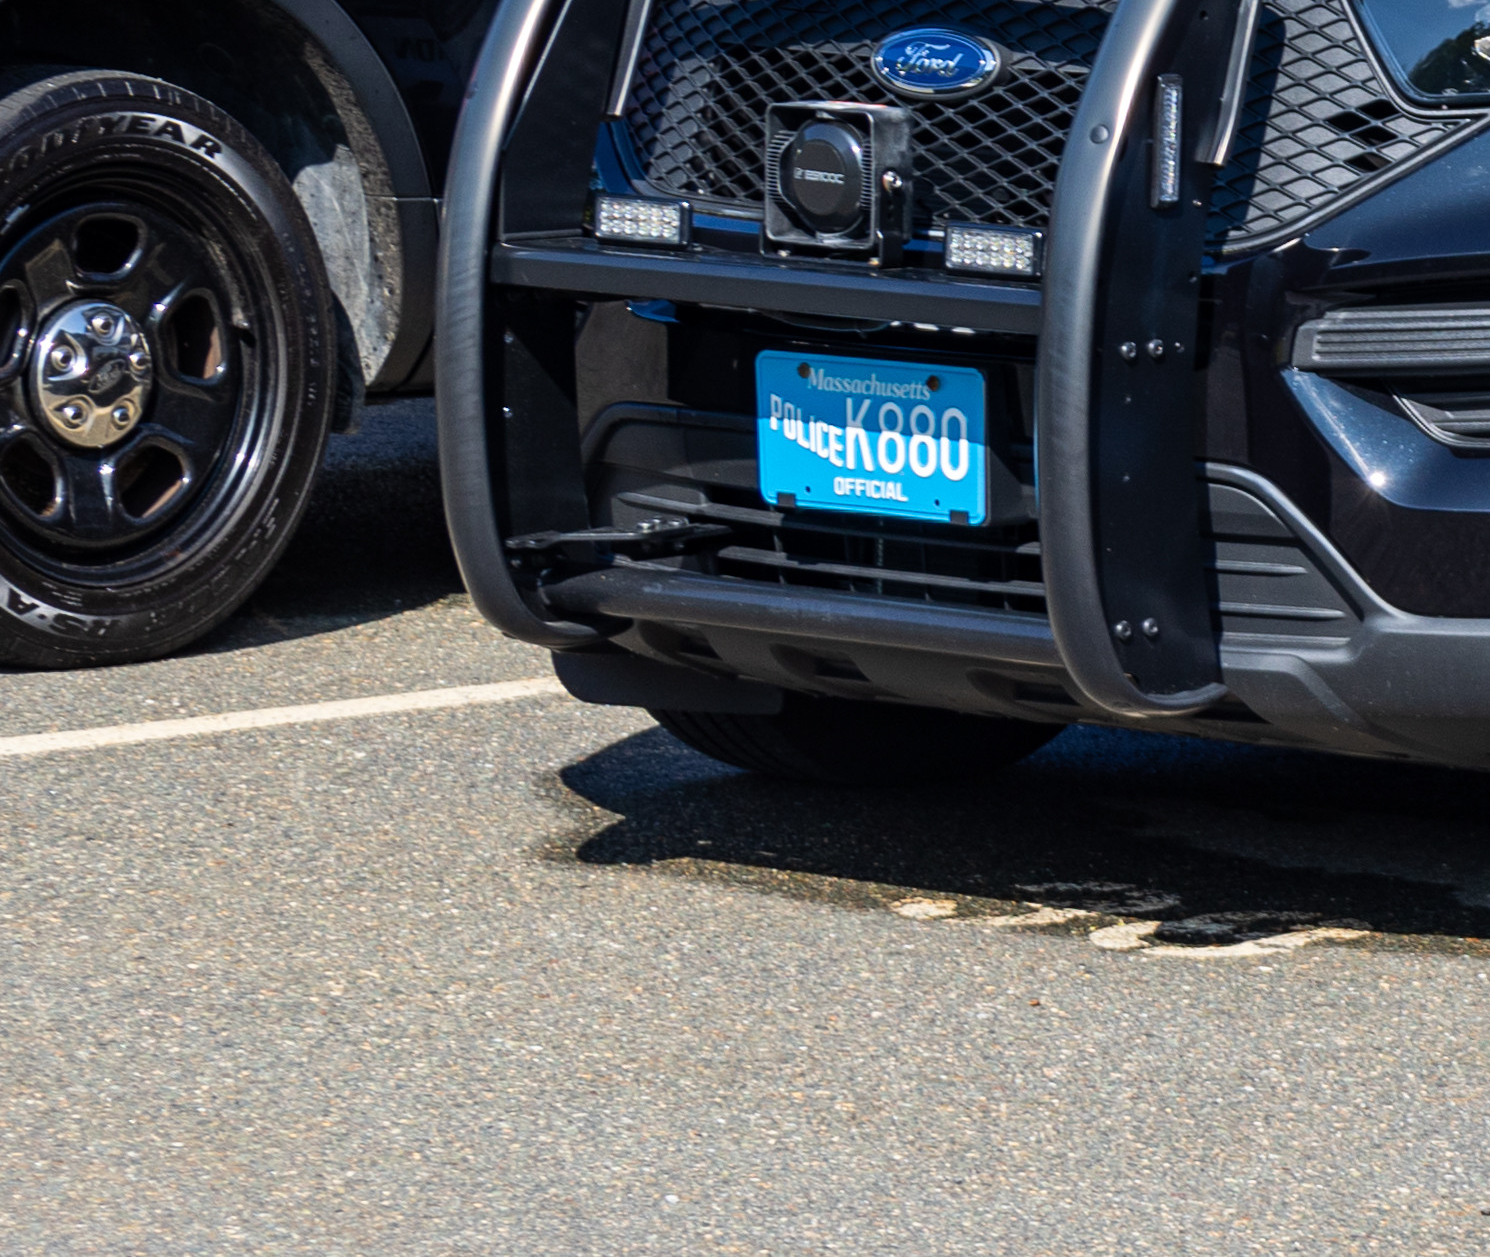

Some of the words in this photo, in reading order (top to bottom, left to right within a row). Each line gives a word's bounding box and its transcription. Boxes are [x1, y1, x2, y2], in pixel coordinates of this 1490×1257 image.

[896, 42, 963, 78] Ford
[808, 367, 931, 400] Massachusetts
[769, 393, 845, 468] POLICE
[845, 396, 970, 482] K880
[833, 476, 909, 503] OFFICIAL
